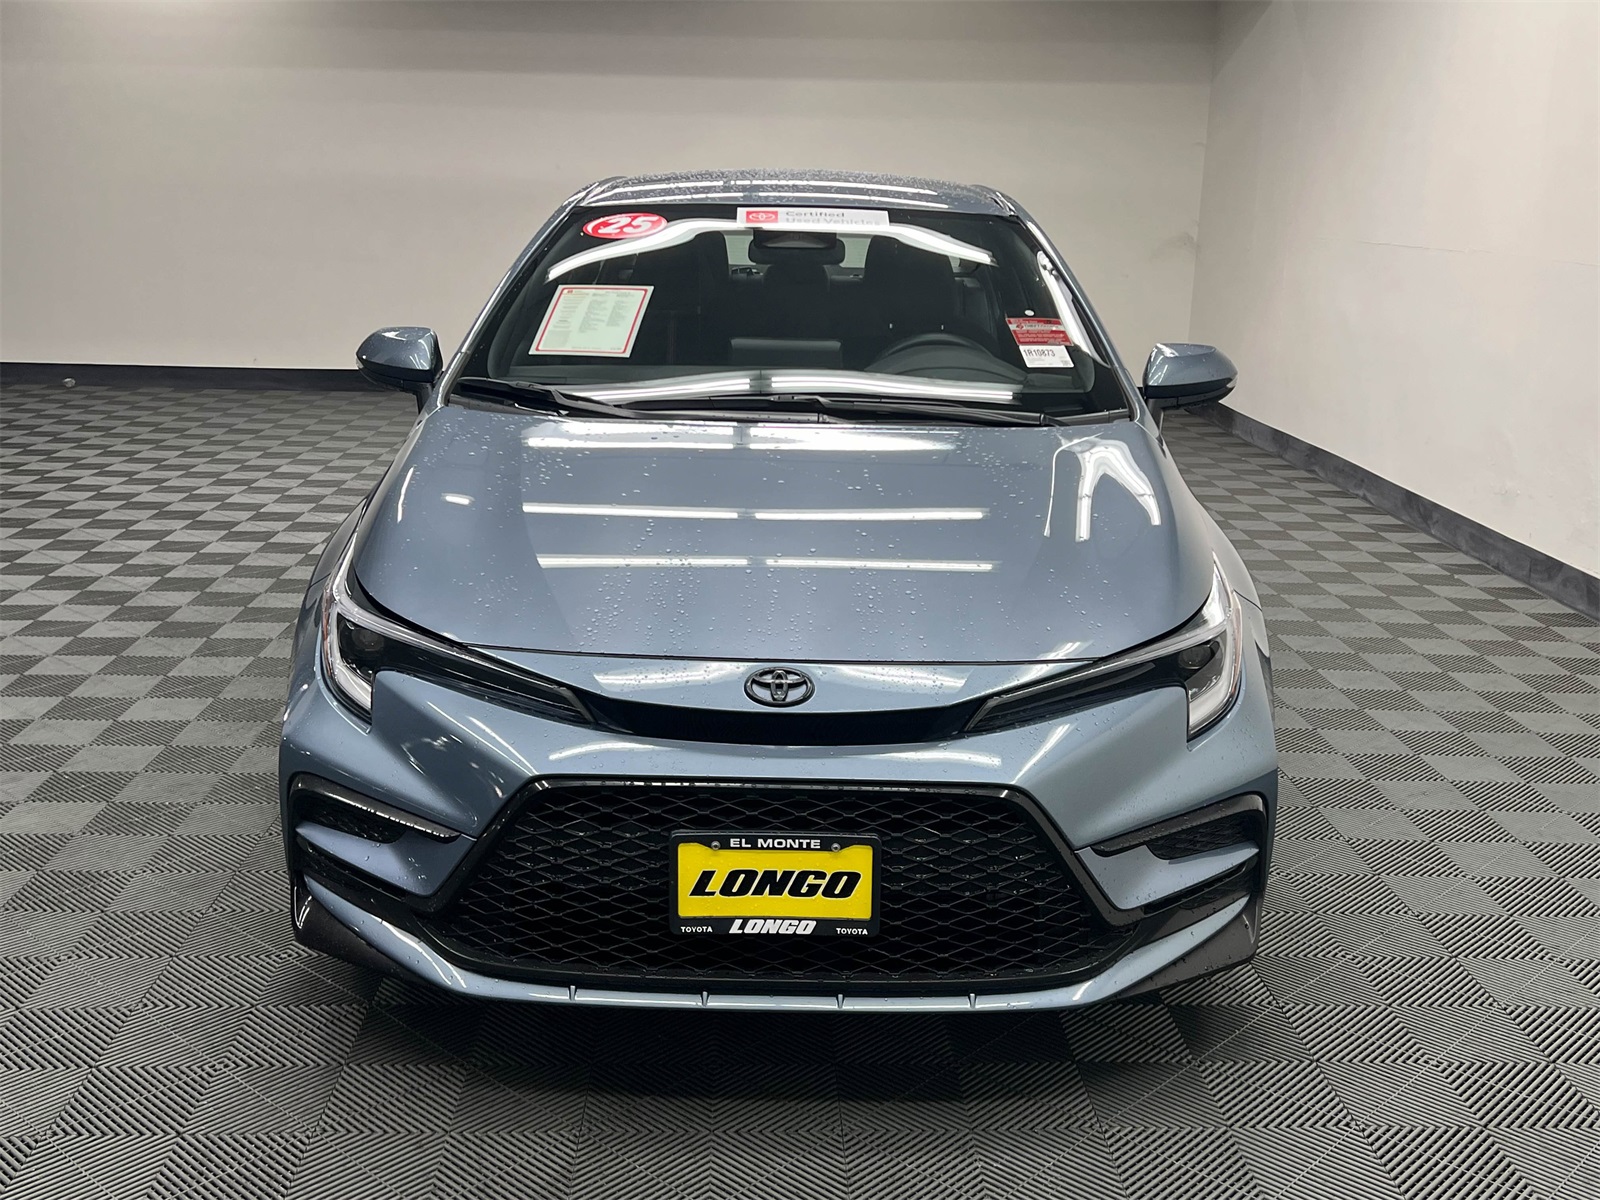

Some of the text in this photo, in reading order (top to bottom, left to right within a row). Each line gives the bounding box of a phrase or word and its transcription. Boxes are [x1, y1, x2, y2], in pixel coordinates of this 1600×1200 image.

[785, 210, 845, 218] Certified
[597, 216, 660, 234] 25
[785, 217, 819, 225] Used
[729, 838, 821, 849] EL MONTE
[688, 868, 862, 899] LONGO
[729, 919, 817, 935] LONGO
[836, 927, 869, 935] TOYOTA
